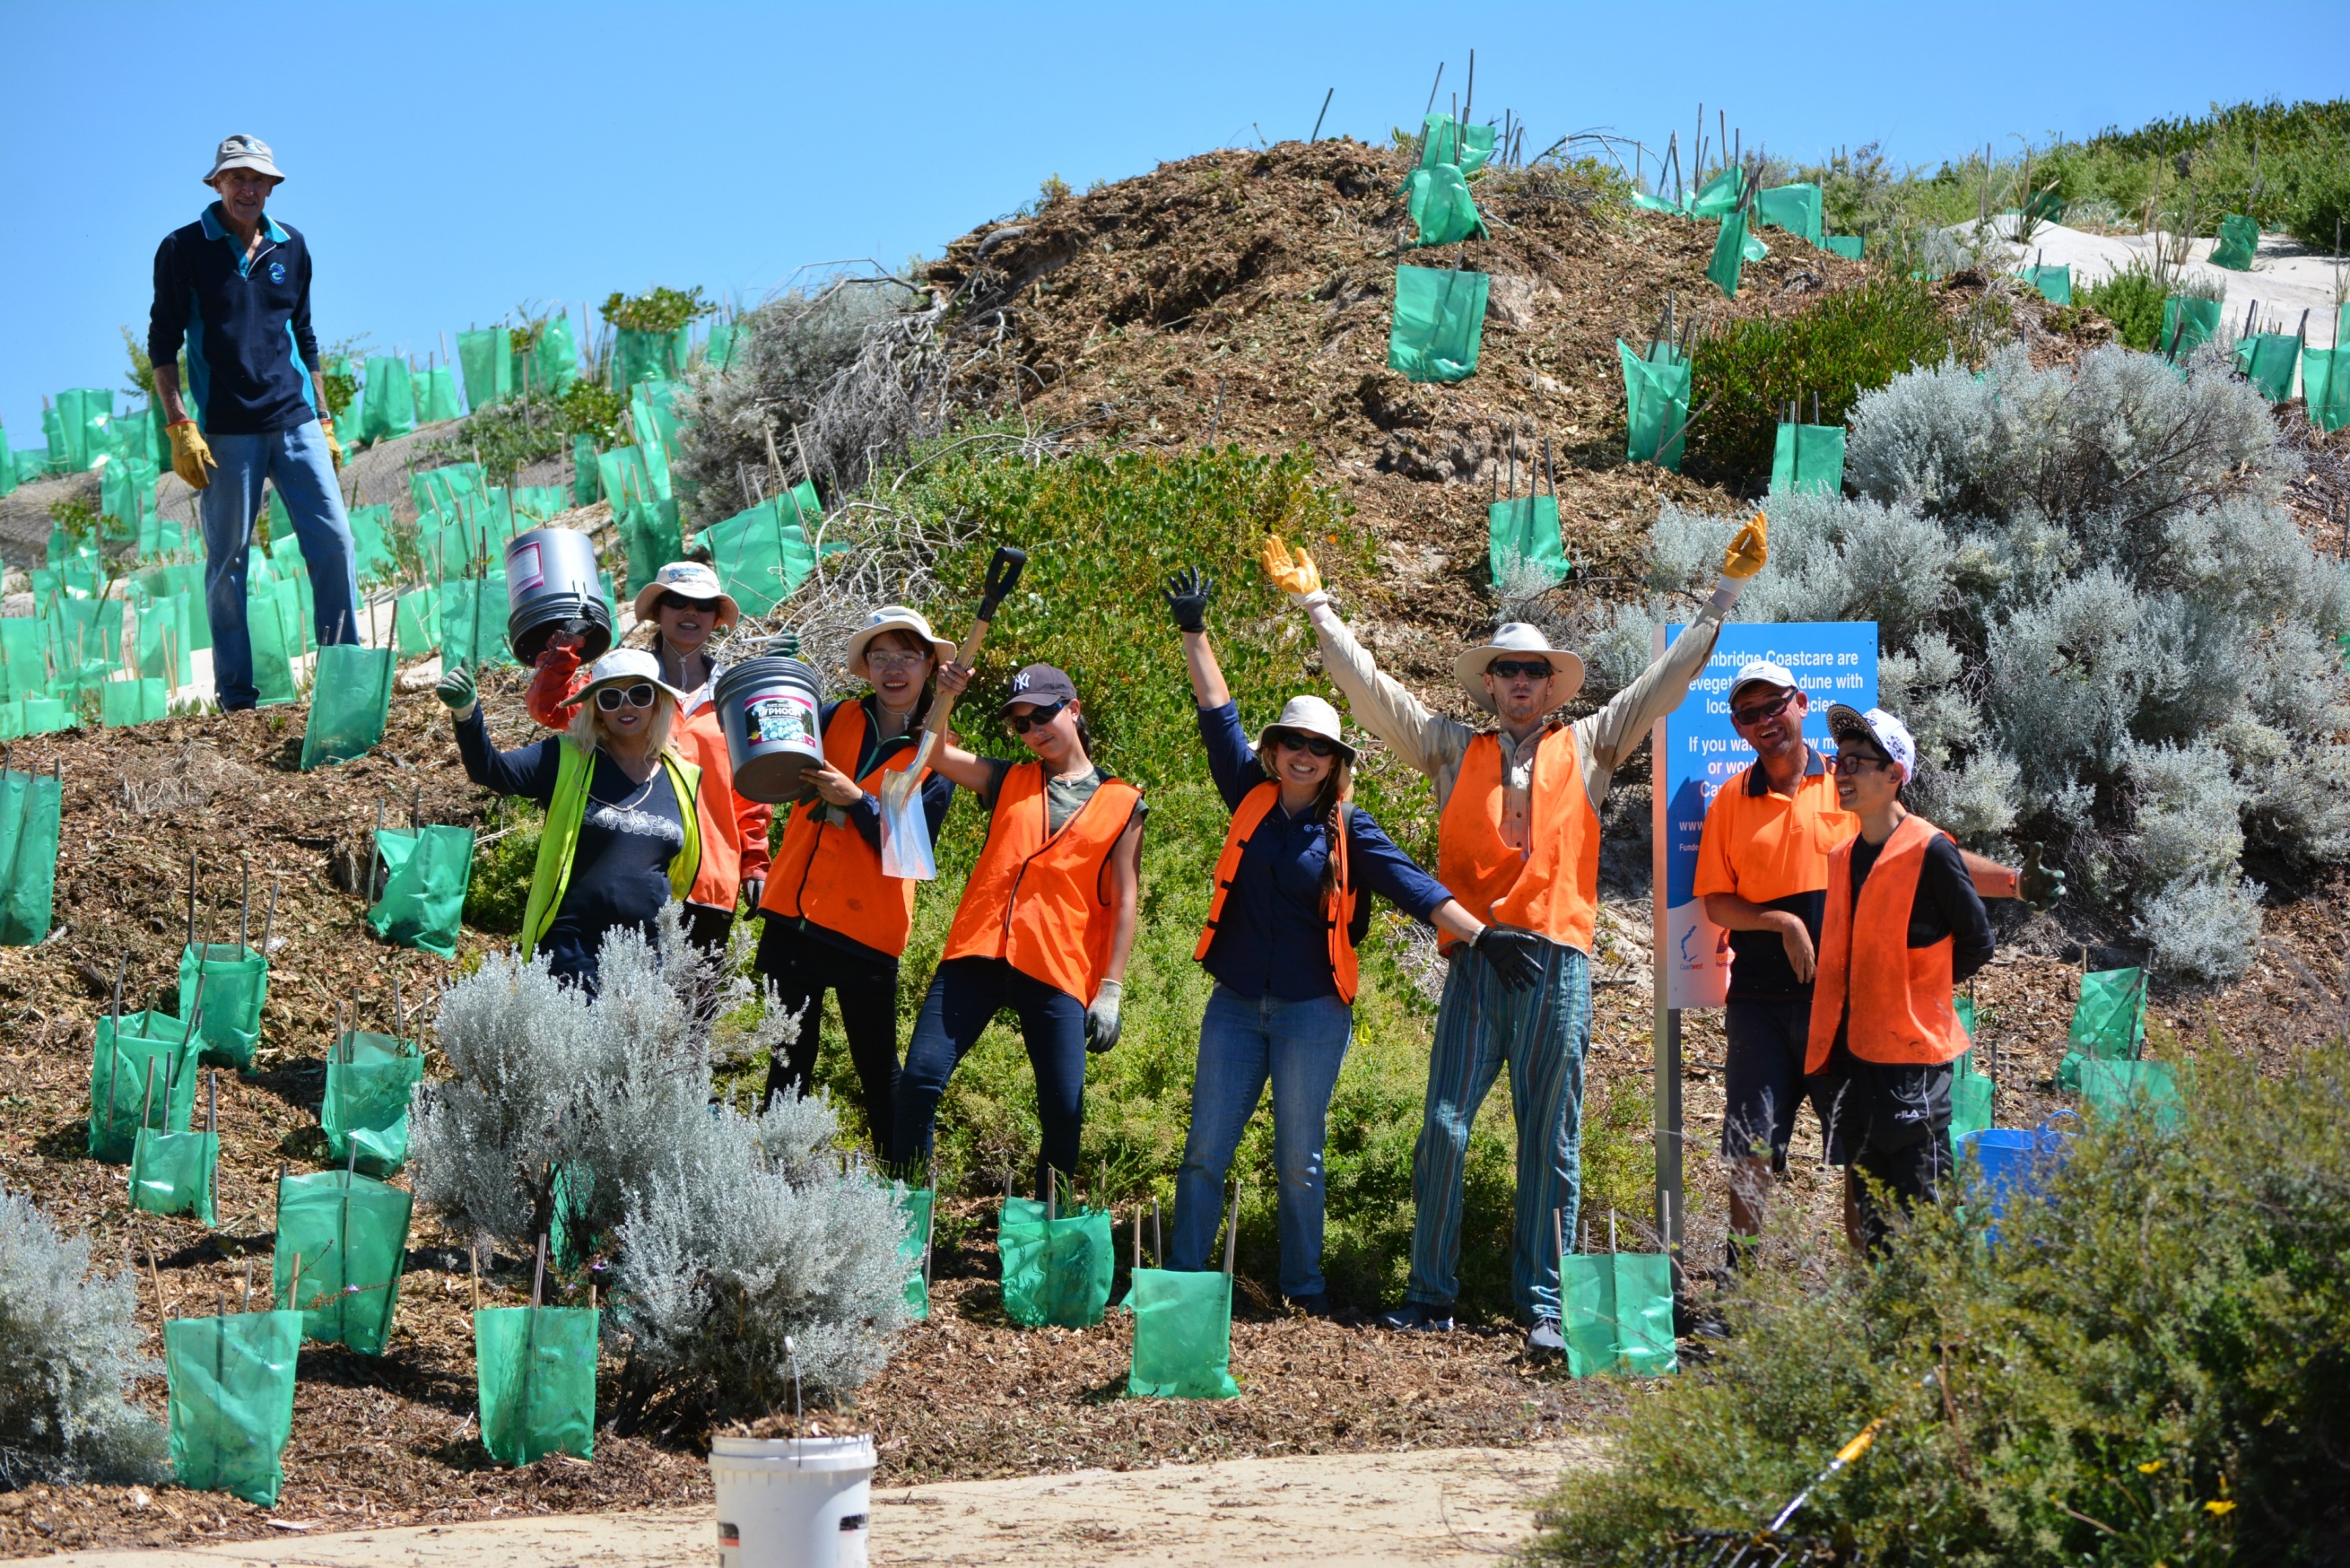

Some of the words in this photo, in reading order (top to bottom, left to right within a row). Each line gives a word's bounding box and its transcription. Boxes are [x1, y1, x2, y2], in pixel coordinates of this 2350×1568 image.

[1766, 650, 1833, 666] Coastcare
[1837, 653, 1858, 665] are
[1014, 673, 1030, 692] NY
[1798, 674, 1832, 689] dune
[1836, 673, 1863, 689] with
[1689, 736, 1698, 751] If
[1702, 740, 1726, 756] you
[1708, 763, 1722, 774] or
